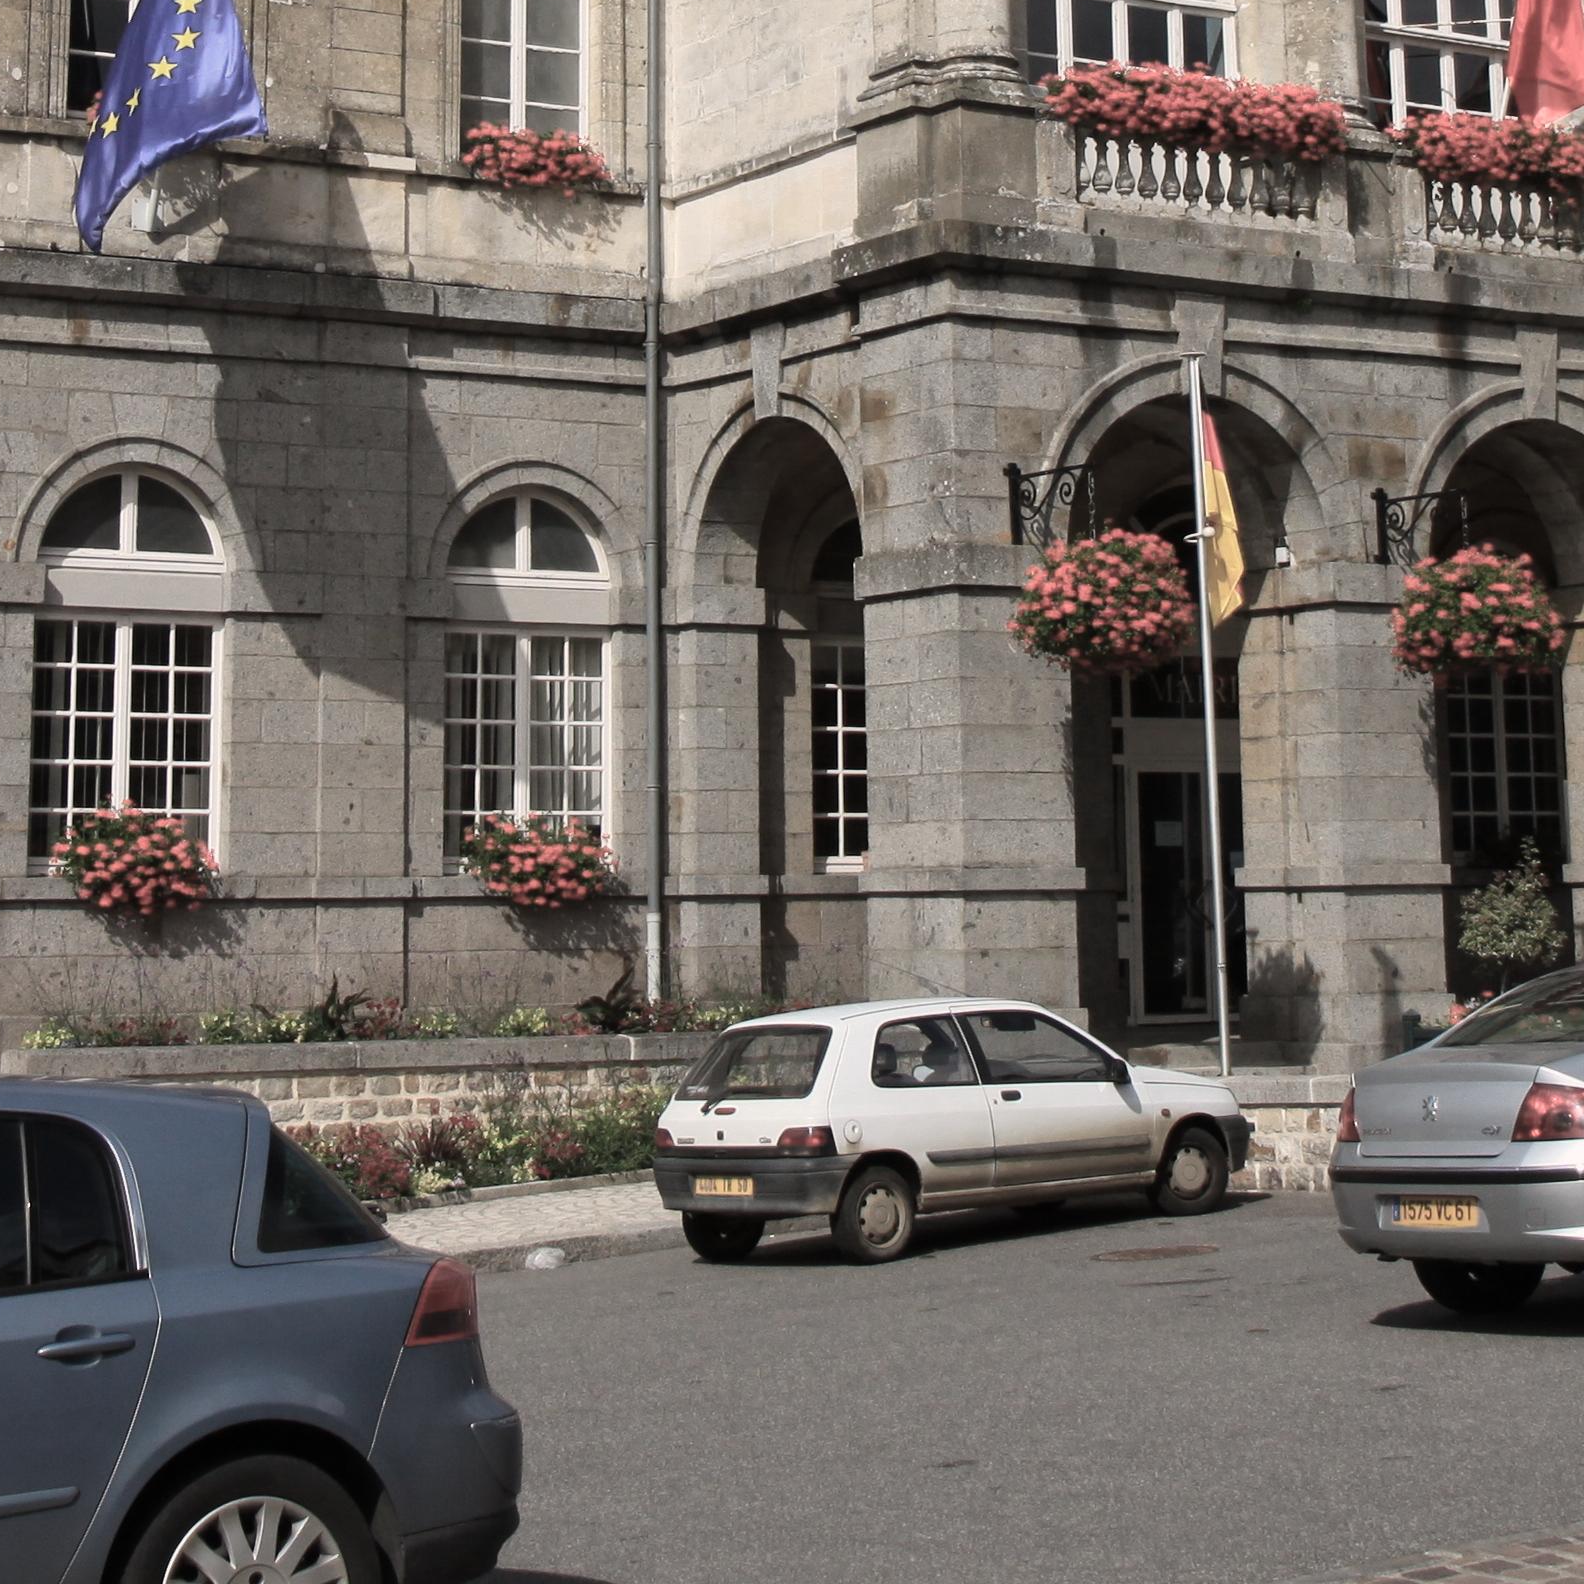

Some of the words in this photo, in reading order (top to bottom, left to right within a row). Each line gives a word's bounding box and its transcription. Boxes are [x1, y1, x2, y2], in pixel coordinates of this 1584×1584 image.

[1148, 672, 1238, 704] MAIRI
[1402, 1199, 1433, 1221] 1575
[1434, 1199, 1452, 1221] VC
[1455, 1199, 1472, 1221] 61
